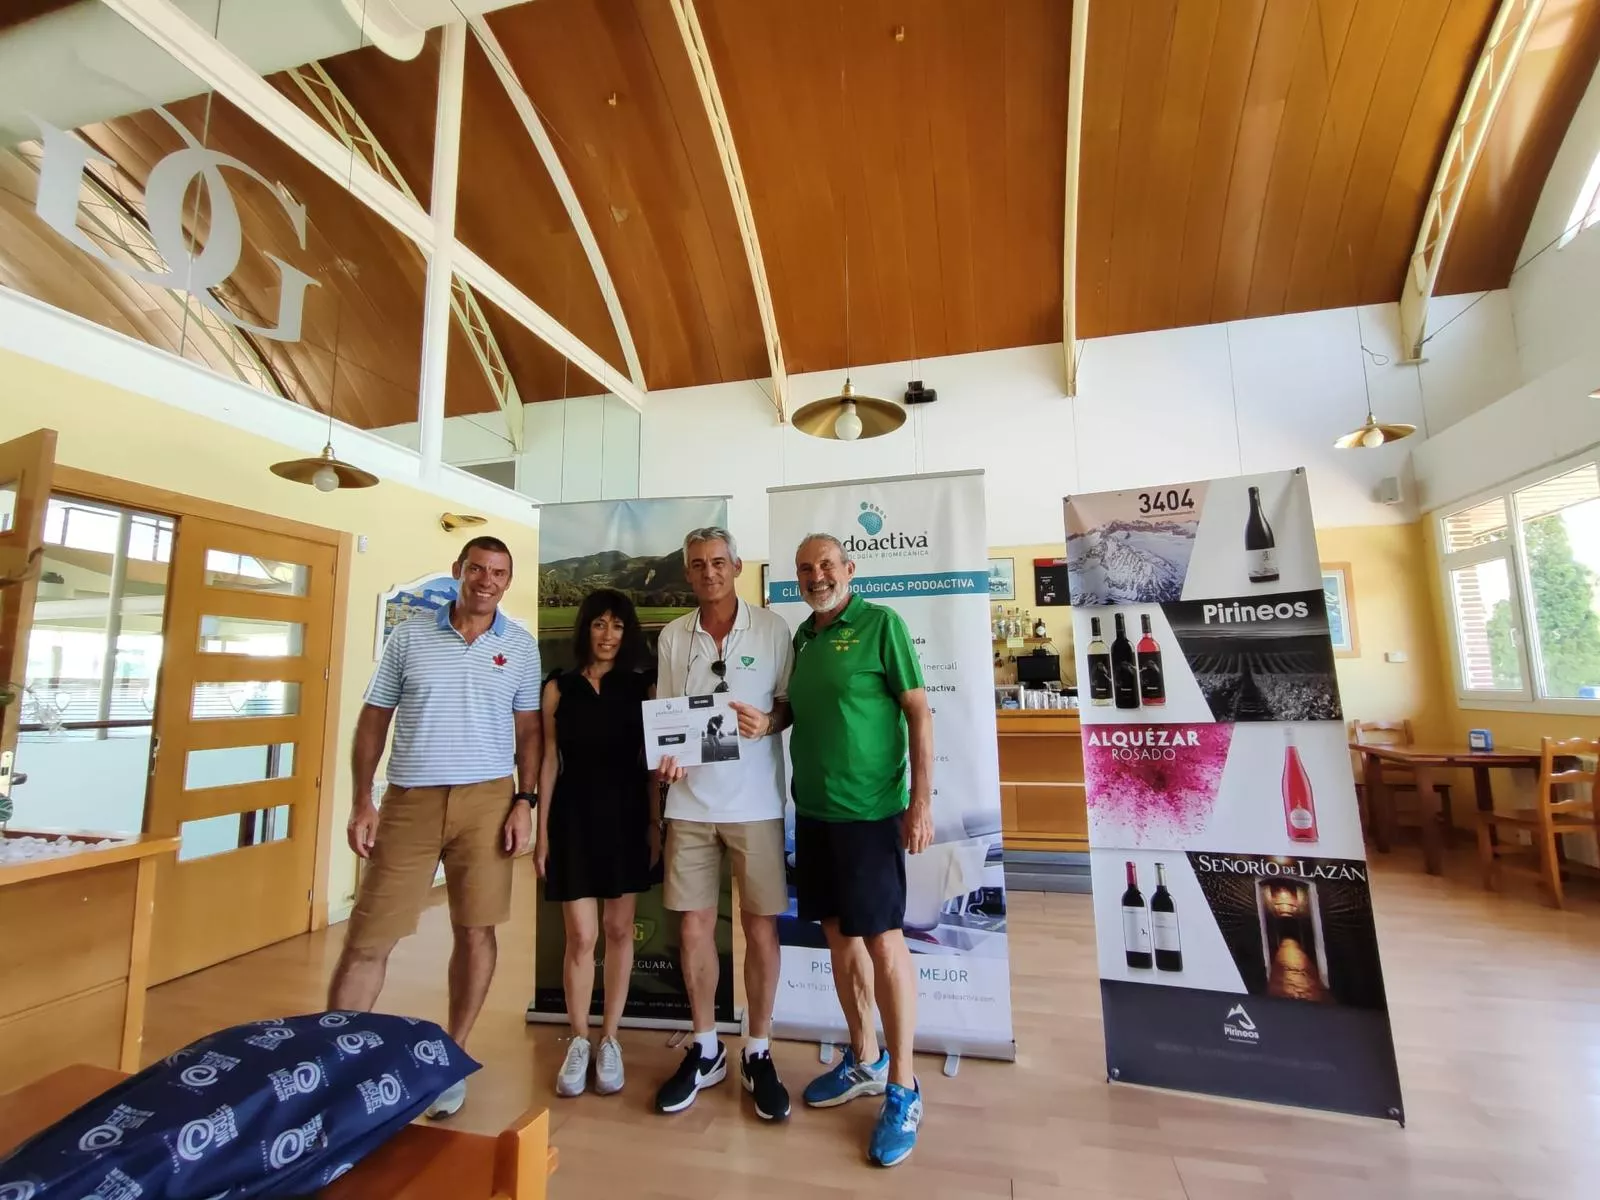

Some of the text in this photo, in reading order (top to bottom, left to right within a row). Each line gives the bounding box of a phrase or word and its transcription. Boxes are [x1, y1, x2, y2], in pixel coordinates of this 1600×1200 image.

[1138, 488, 1195, 514] 3404
[843, 532, 929, 553] doactiva
[849, 552, 873, 560] OLOGÍA
[846, 578, 975, 594] DOLÓGICAS PODOACTIVA
[1203, 601, 1309, 625] Pirineos
[923, 684, 956, 693] oactiva
[1088, 727, 1201, 747] ALQUÉZAR
[1112, 748, 1176, 761] ROSADO
[1198, 855, 1367, 882] SEÑORÍO DE LAZÁN
[637, 960, 673, 969] GUARA
[811, 961, 968, 982] PIS MEJOR
[362, 1078, 382, 1114] MIGUEL
[208, 1107, 232, 1148] MIGUEL
